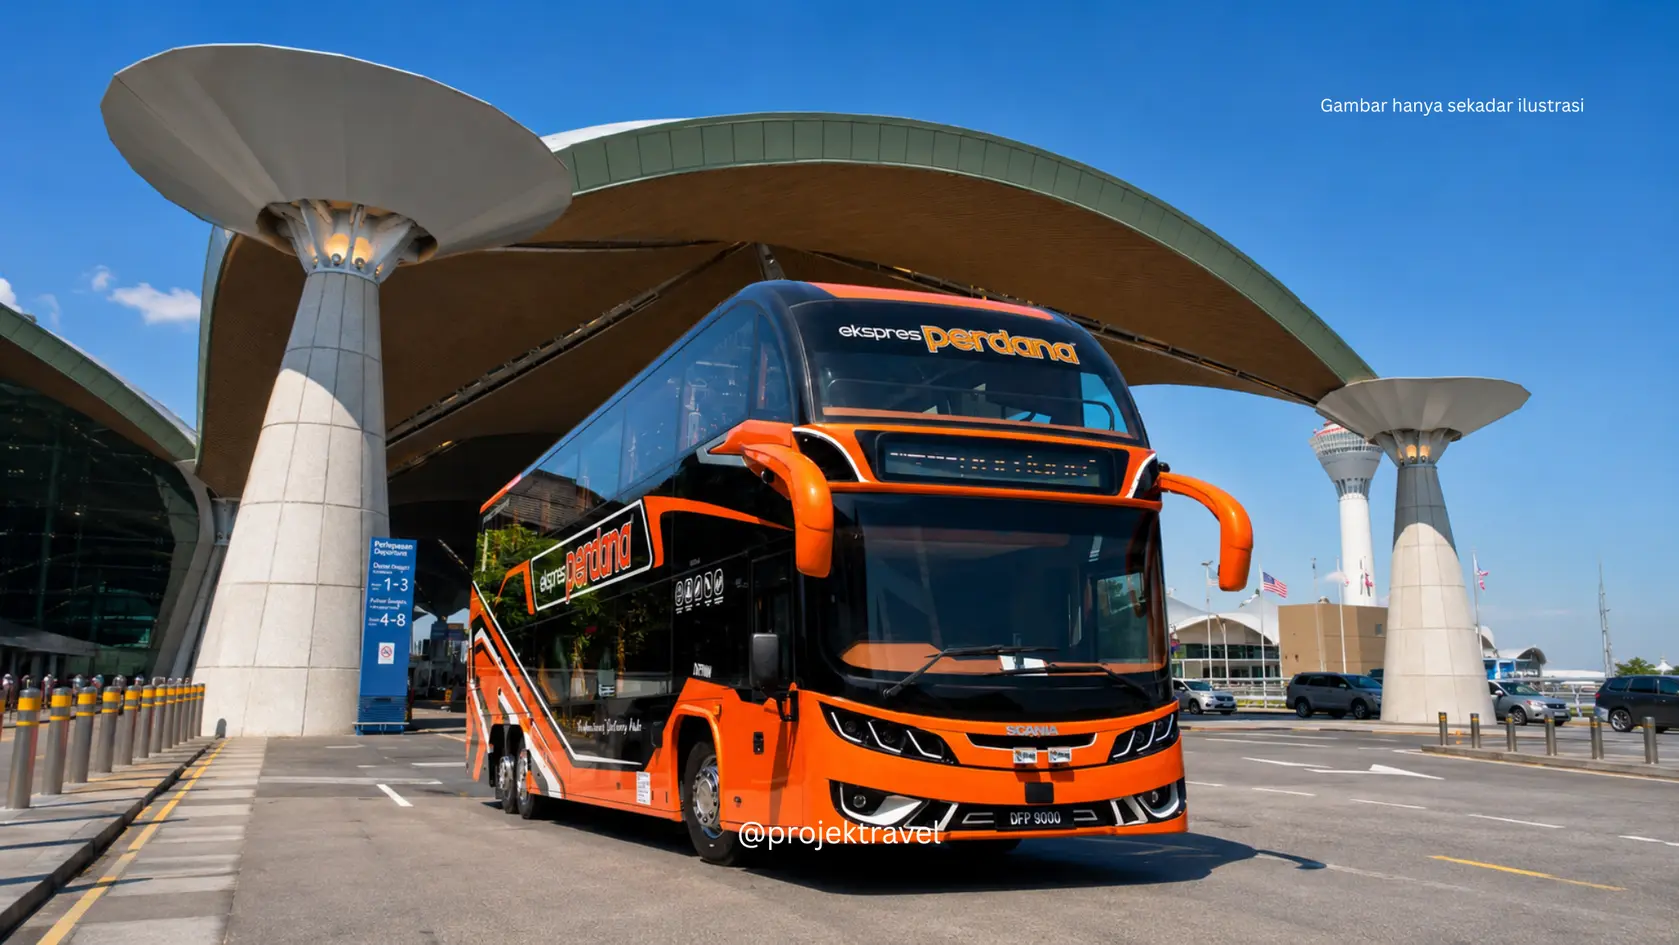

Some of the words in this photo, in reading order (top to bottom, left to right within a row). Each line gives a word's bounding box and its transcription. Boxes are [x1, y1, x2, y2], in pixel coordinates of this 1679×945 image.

[838, 324, 922, 341] ekspres
[920, 324, 1081, 365] perdana
[565, 520, 632, 604] perdana
[384, 577, 409, 591] 1-3
[380, 613, 406, 626] 4-8
[1006, 725, 1059, 736] SCANIA
[1010, 812, 1031, 825] DFP
[1034, 811, 1061, 824] 9000
